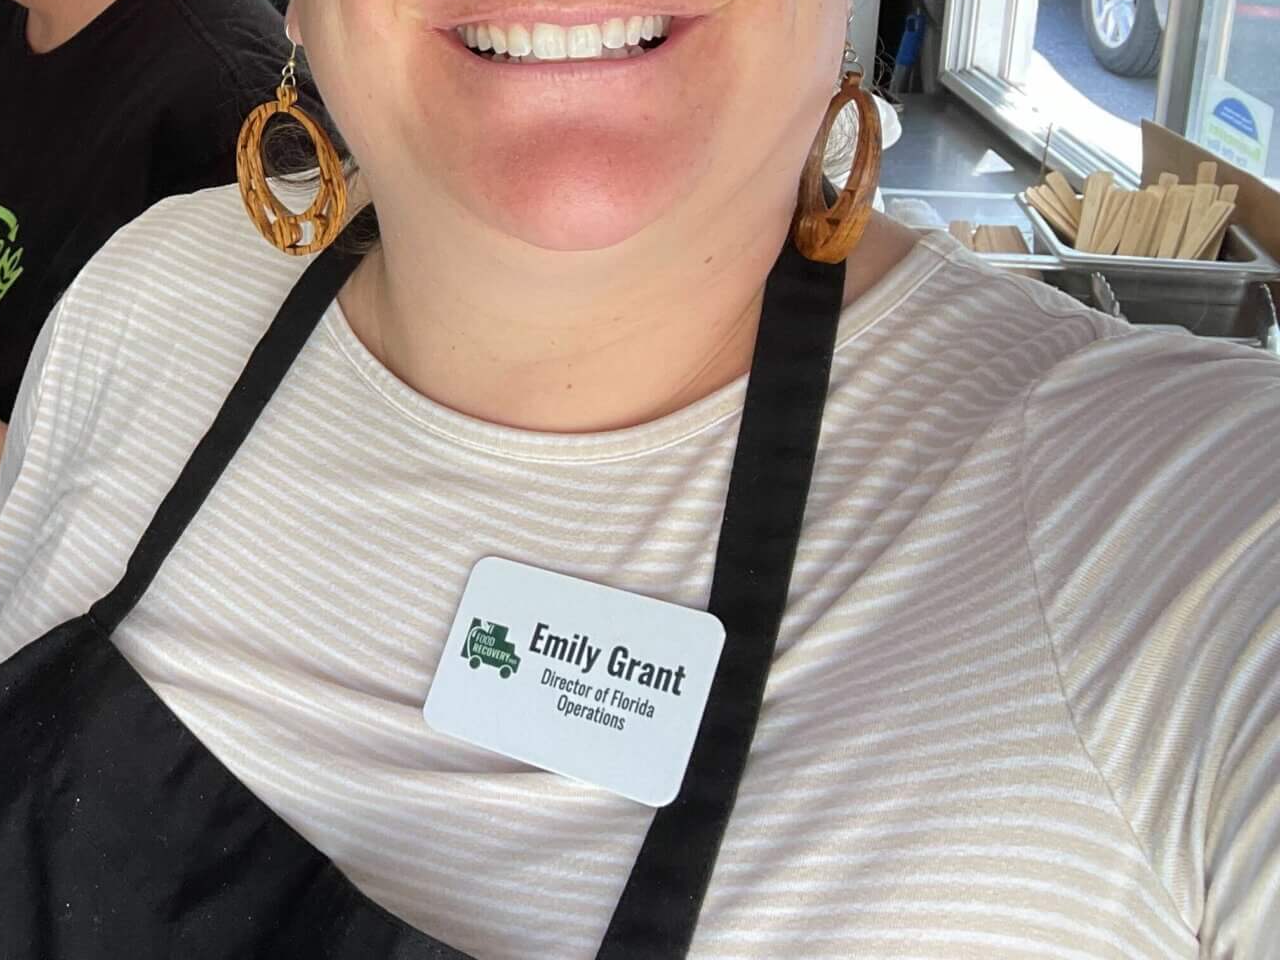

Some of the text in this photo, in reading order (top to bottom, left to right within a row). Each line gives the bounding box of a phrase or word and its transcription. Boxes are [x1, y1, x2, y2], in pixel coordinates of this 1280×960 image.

[529, 622, 686, 696] Emily Grant
[540, 668, 655, 718] Director of Florida
[556, 694, 626, 730] Operations
